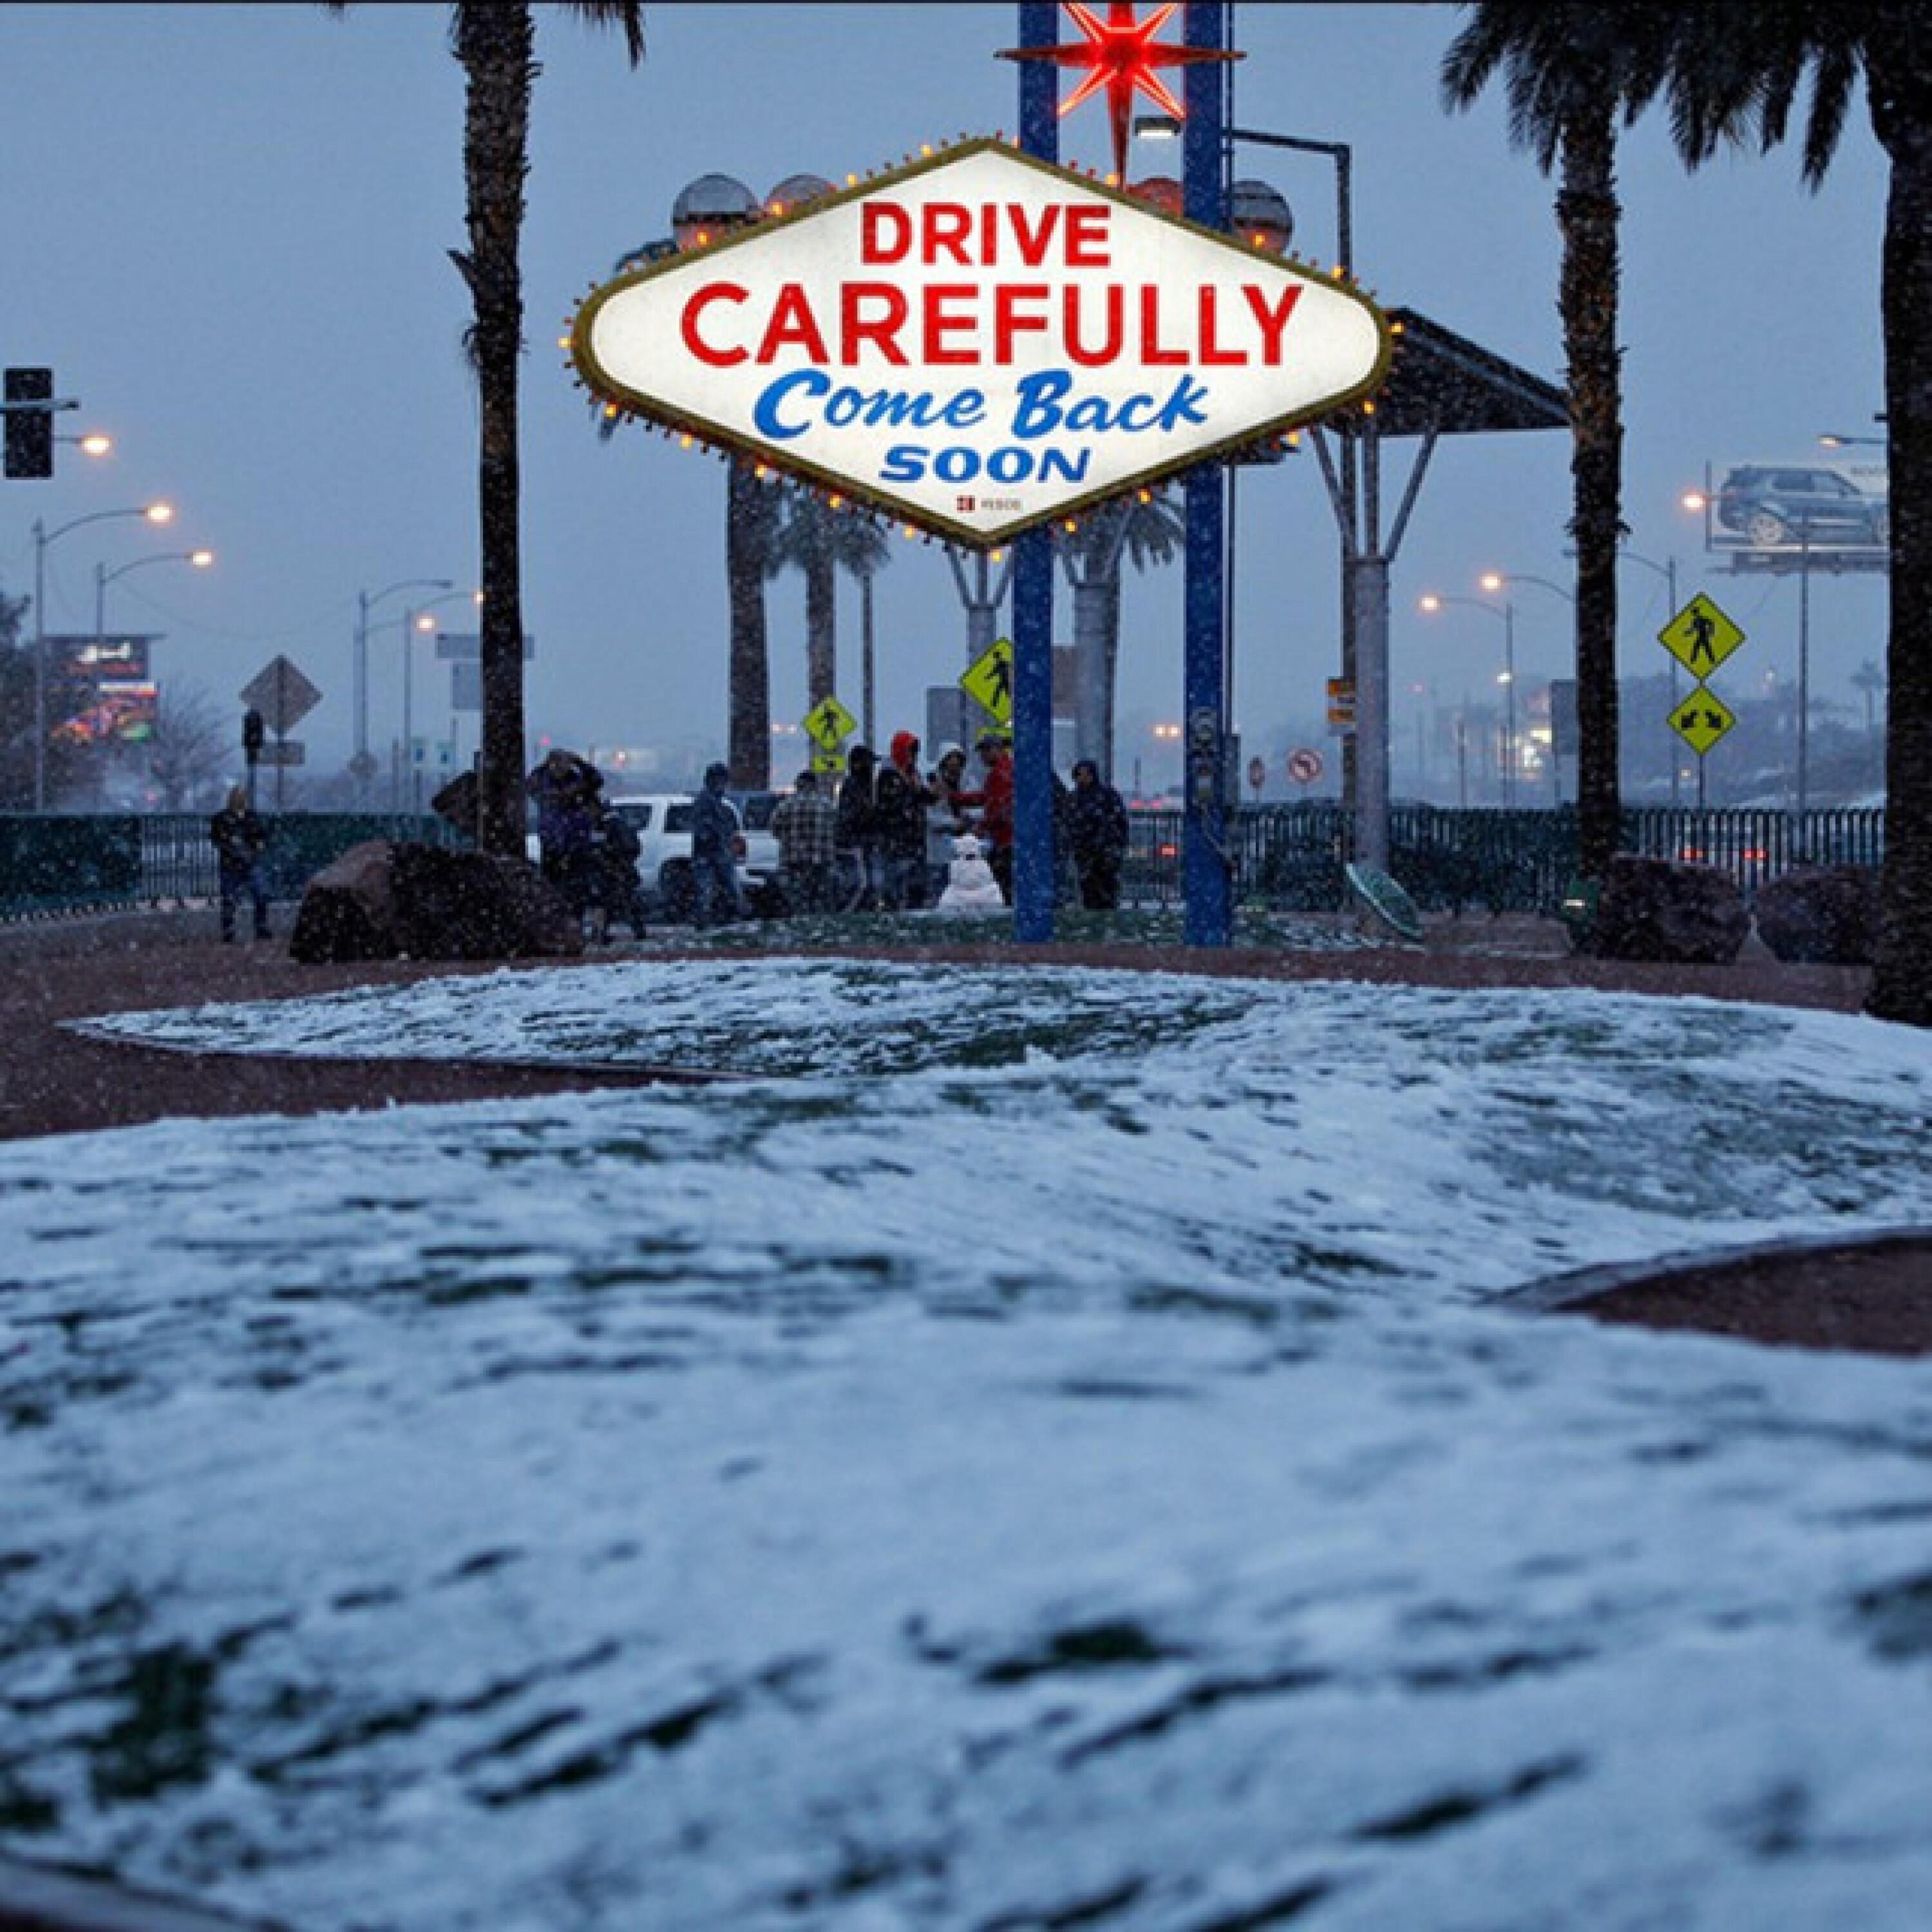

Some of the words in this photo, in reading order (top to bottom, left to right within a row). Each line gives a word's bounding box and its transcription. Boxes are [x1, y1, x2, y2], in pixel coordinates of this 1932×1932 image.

[860, 202, 1112, 269] DRIVE
[681, 281, 1304, 368] CAREFULLY
[753, 367, 985, 440] Come
[1010, 367, 1209, 440] Back
[880, 445, 1092, 484] SOON
